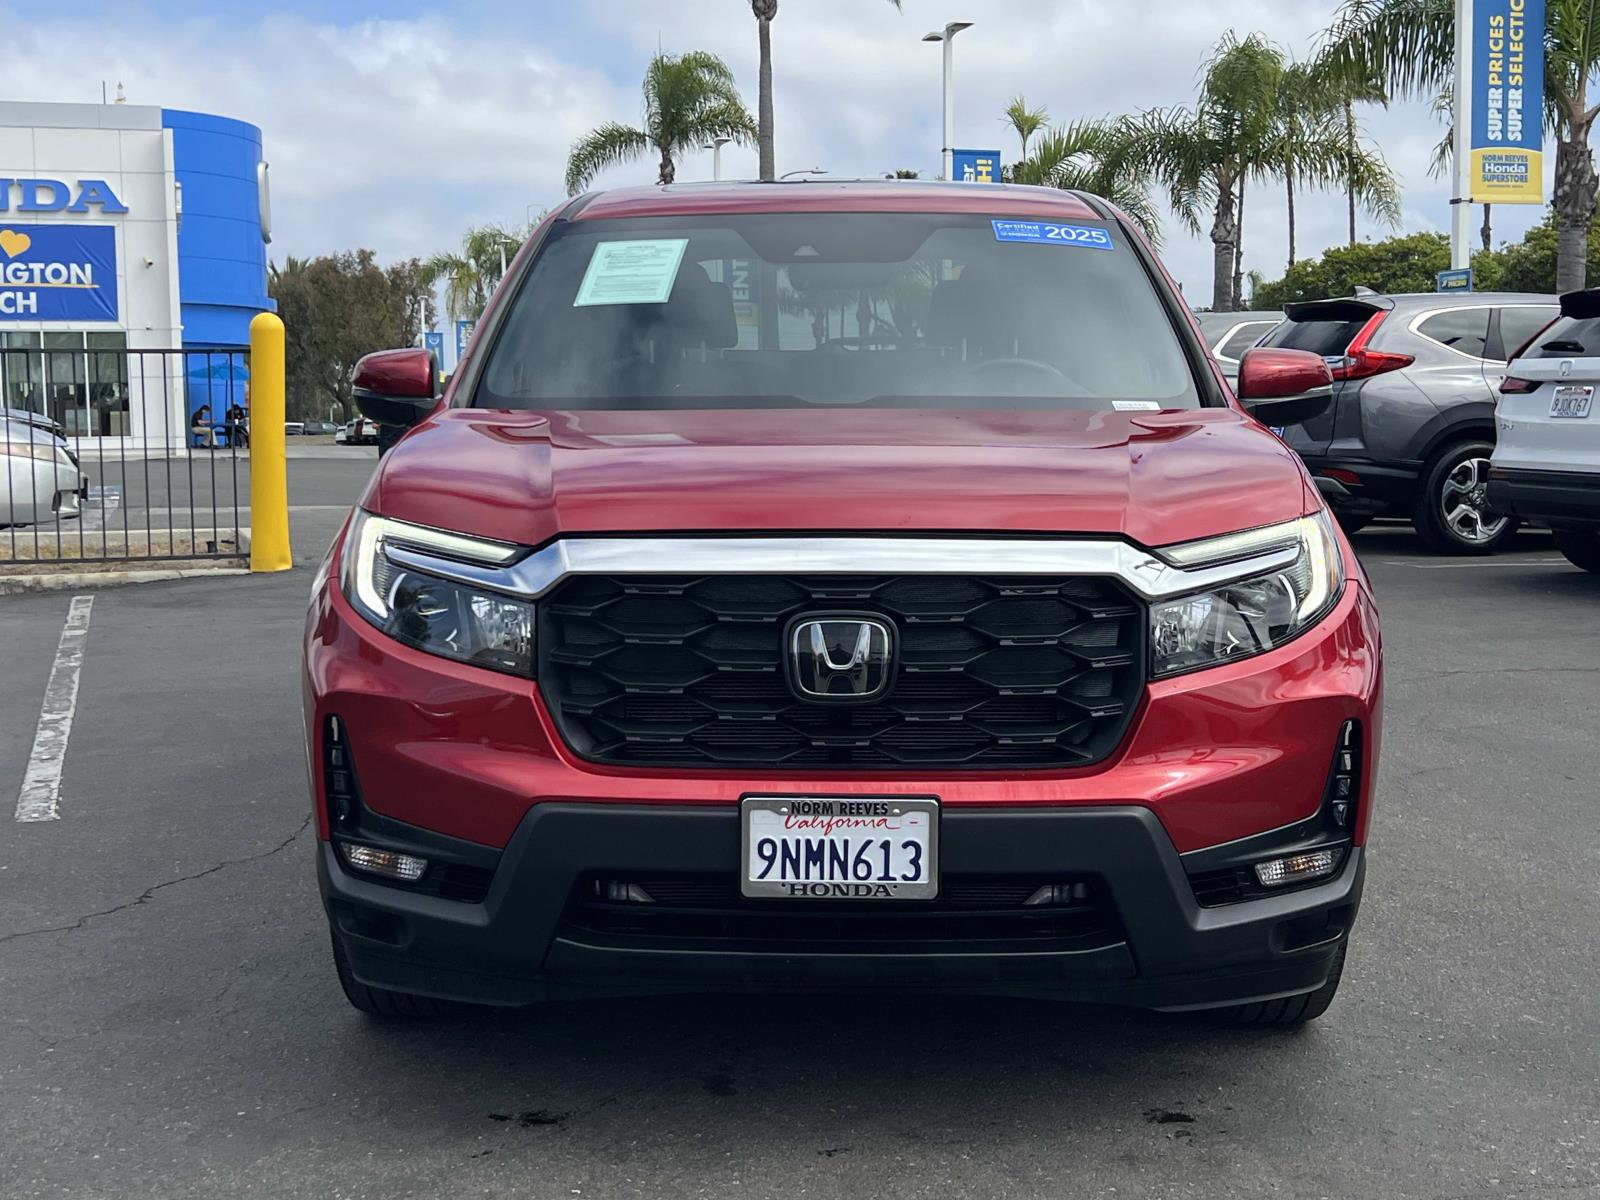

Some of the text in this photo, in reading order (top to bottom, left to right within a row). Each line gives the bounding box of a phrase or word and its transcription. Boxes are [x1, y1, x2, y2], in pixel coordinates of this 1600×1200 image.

[1487, 15, 1504, 141] SUPER PRICES
[1507, 88, 1523, 142] SUPER
[1482, 155, 1528, 163] NORM REEVES
[1484, 163, 1526, 173] Honda
[1482, 174, 1528, 183] SUPERSTORE
[1044, 226, 1107, 243] 2025
[791, 801, 889, 816] NORM REEVES
[784, 814, 901, 836] California
[757, 838, 922, 881] 9NMN613
[789, 883, 894, 897] HONDA
